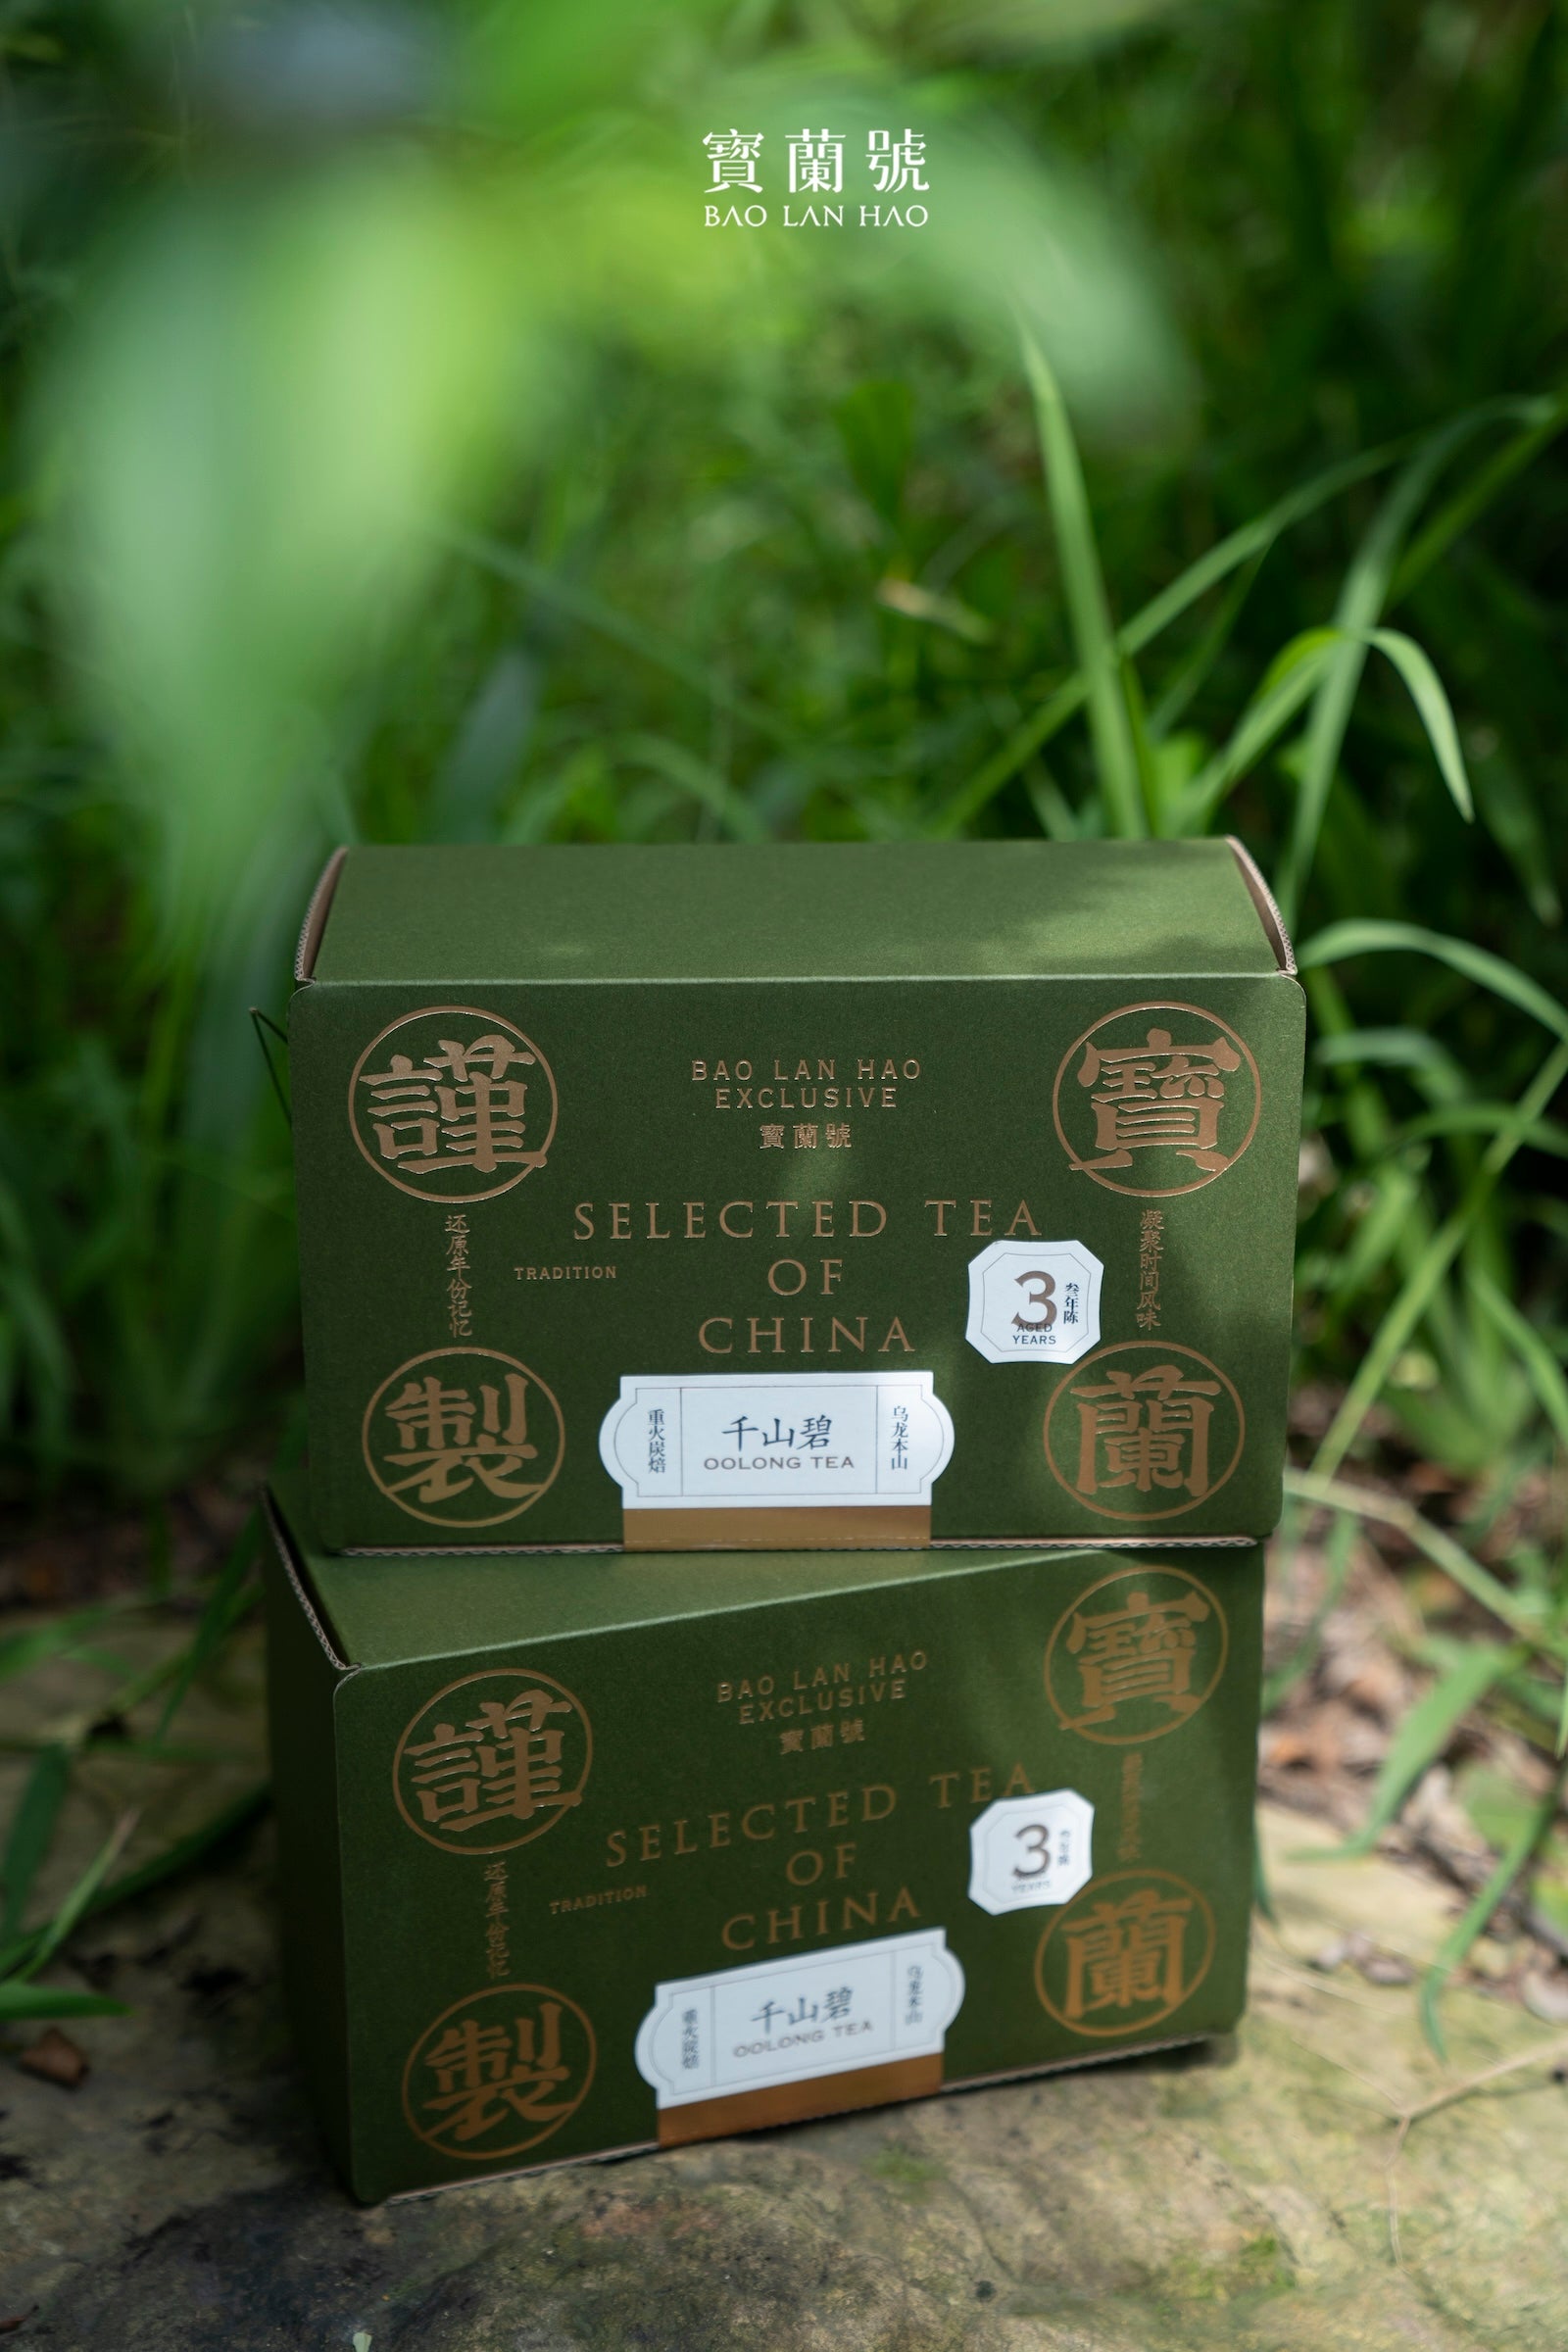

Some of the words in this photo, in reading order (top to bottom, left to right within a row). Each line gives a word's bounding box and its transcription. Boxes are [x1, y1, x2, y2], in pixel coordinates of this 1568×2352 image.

[692, 1059, 754, 1081] BAO
[774, 1059, 835, 1080] LAN
[858, 1058, 921, 1079] HAO
[359, 1035, 547, 1173] 謹
[715, 1087, 897, 1108] EXCLUSIVE
[573, 1200, 887, 1240] SELECTED
[926, 1199, 1042, 1237] TEA
[444, 1213, 473, 1339] 还原年份记忆
[514, 1266, 616, 1280] TRADITION
[767, 1259, 843, 1296] OF
[1136, 1208, 1165, 1331] 凝聚时间风味
[1011, 1270, 1057, 1331] 3
[699, 1316, 915, 1353] CHINA
[1012, 1335, 1056, 1345] YEARS
[1016, 1323, 1053, 1333] AGED
[383, 1373, 546, 1503] 製
[648, 1408, 666, 1474] 重火炭焙
[722, 1414, 832, 1452] 千山碧
[891, 1405, 908, 1470] 乌龙本山
[1070, 1365, 1222, 1496] 蘭
[704, 1456, 801, 1470] OOLONG
[810, 1456, 854, 1468] TEA
[717, 1675, 774, 1703] BAO
[793, 1662, 850, 1690] LAN
[869, 1650, 926, 1678] HAO
[739, 1679, 906, 1725] EXCLUSIVE
[404, 1690, 582, 1832] 謹
[605, 1784, 897, 1867] SELECTED
[929, 1763, 1037, 1808] TEA
[787, 1842, 857, 1886] OF
[1012, 1823, 1051, 1879] 3
[549, 1886, 648, 1915] TRADITION
[721, 1886, 921, 1950] CHINA
[1061, 1890, 1190, 2020] 蘭
[750, 1986, 853, 2035] 千山碧
[733, 2030, 824, 2057] OOLONG
[832, 2021, 872, 2037] TEA
[422, 2002, 578, 2141] 製
